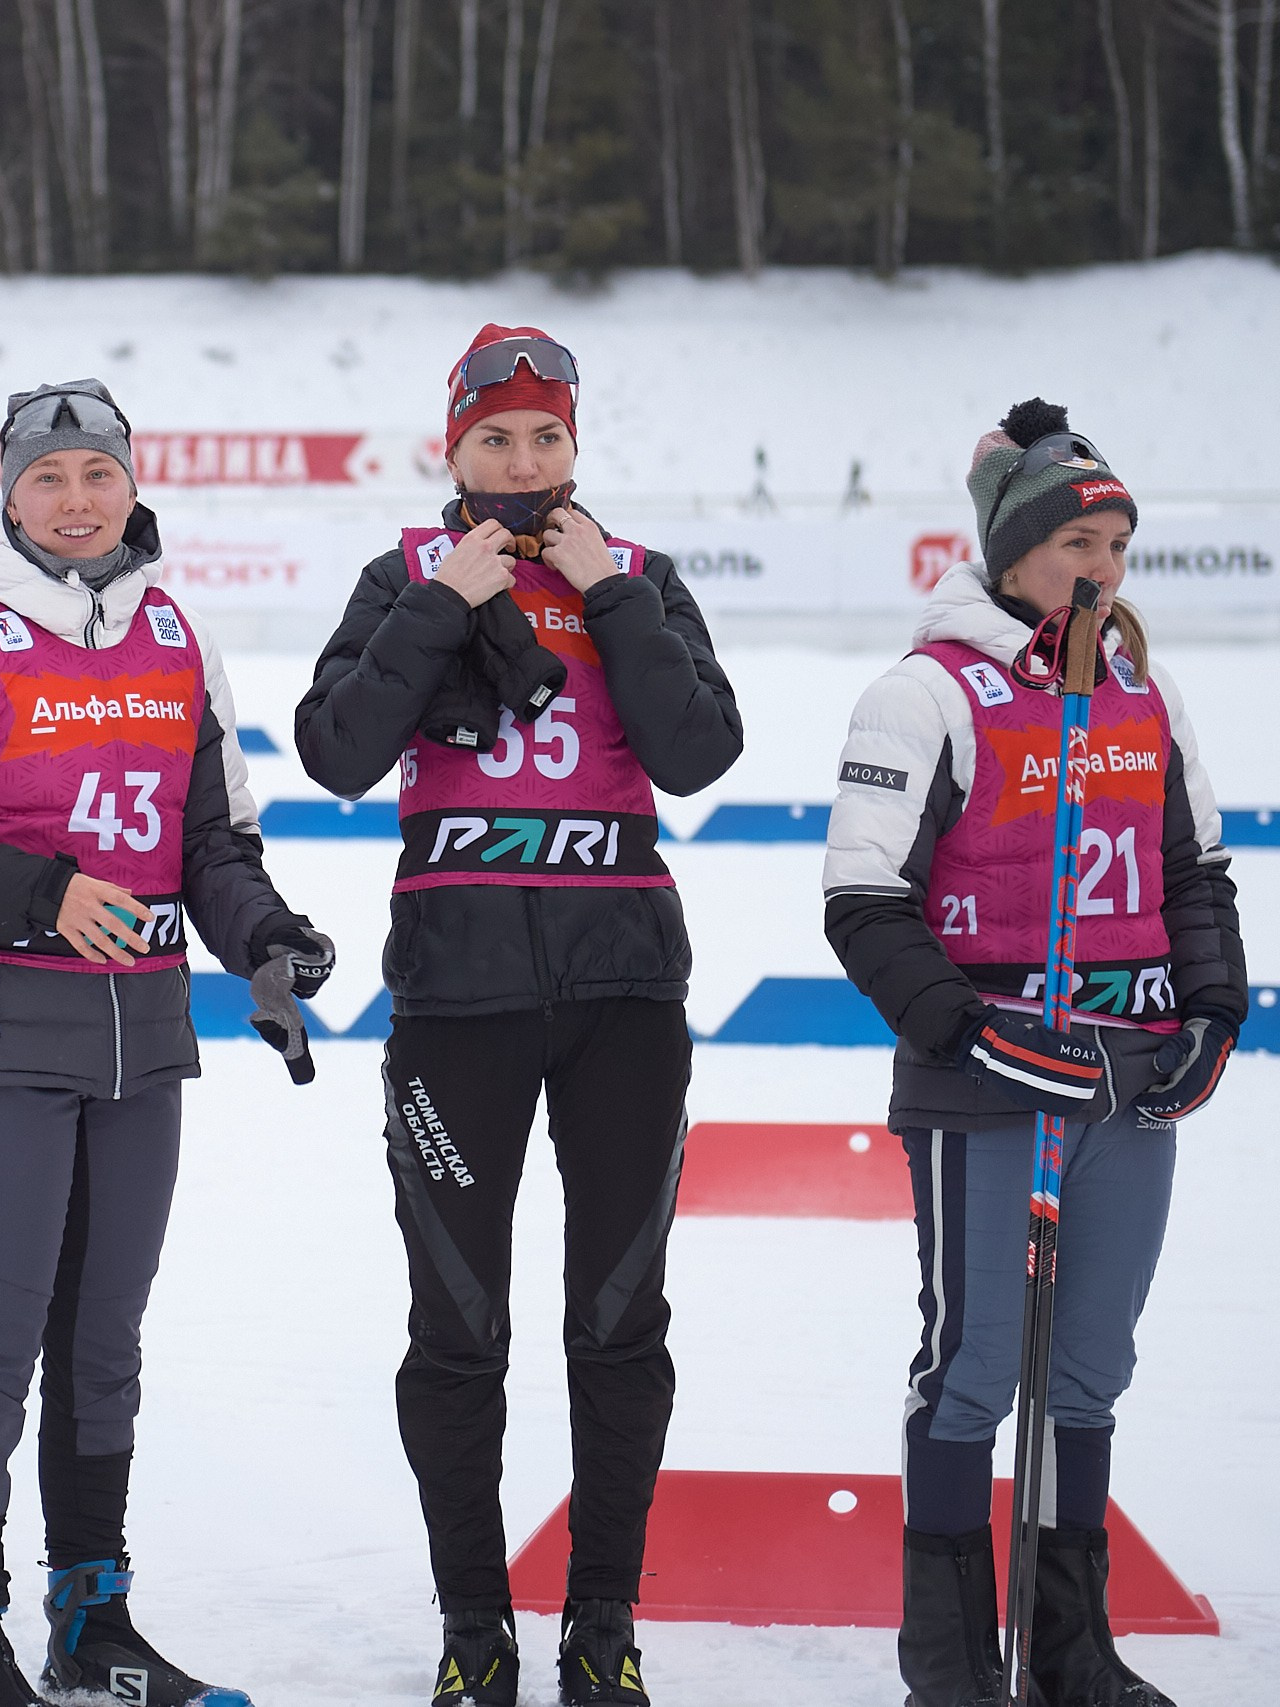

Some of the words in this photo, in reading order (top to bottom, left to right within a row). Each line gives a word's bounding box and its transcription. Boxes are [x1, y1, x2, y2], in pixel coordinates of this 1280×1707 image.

[454, 390, 477, 418] PARI
[1082, 483, 1111, 497] Альфа
[155, 617, 178, 630] 2024
[545, 607, 588, 634] Ба
[159, 628, 182, 642] 2025
[31, 694, 122, 724] Альфа
[125, 693, 186, 721] Банк
[477, 696, 580, 780] 35
[1107, 745, 1158, 773] Банк
[847, 765, 897, 786] MOAX
[68, 771, 162, 852] 43
[428, 817, 620, 866] PARI
[1076, 827, 1140, 917] 21
[941, 895, 978, 935] 21
[1060, 1044, 1097, 1061] MOAX
[1142, 1101, 1181, 1112] MOAX
[402, 1103, 446, 1181] ОБЛАСТЬ
[408, 1077, 475, 1188] ТЮМЕНСКАЯ
